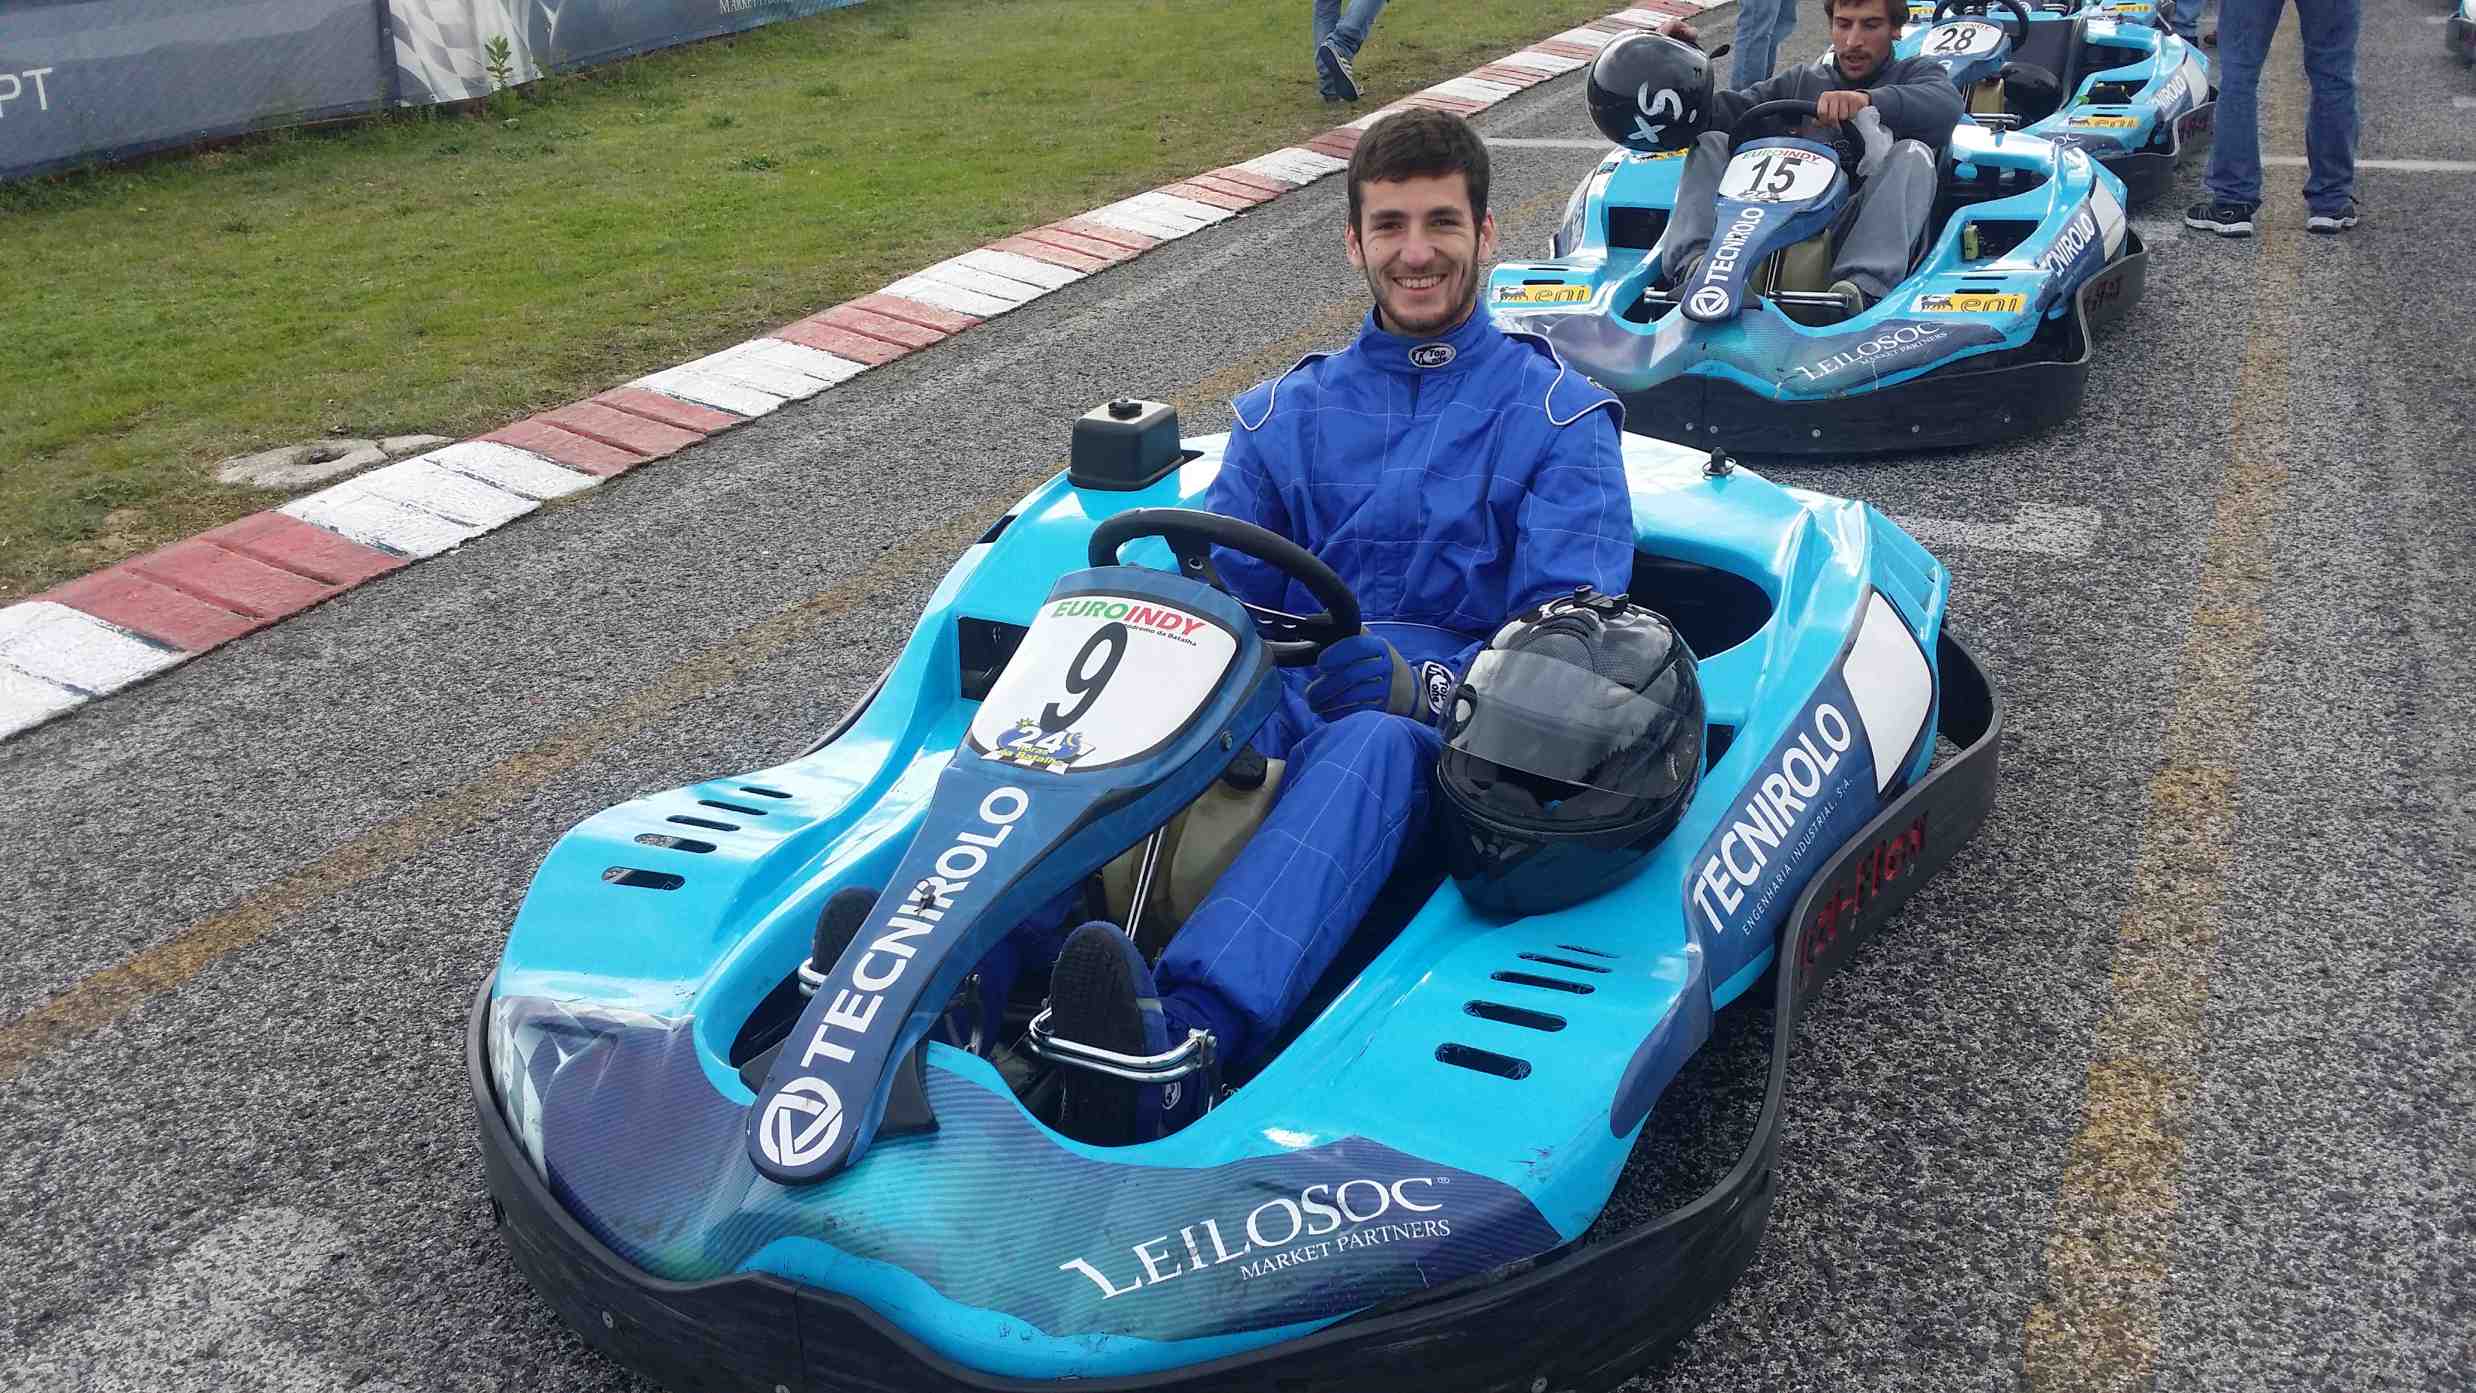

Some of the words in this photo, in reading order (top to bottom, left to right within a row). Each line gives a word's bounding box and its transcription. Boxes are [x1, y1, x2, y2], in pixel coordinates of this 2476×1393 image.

[1934, 27, 1977, 51] 28
[1750, 156, 1801, 194] 15
[1704, 207, 1765, 285] TECNIROLO
[1960, 294, 2018, 313] eni
[1795, 322, 1941, 382] LEILOSOC
[1052, 601, 1206, 636] EUROINDY
[1039, 621, 1128, 733] 9
[1008, 726, 1067, 754] 24
[1693, 703, 1851, 934] TECNIROLO
[800, 786, 1030, 1068] TECNIROLO
[1742, 863, 1793, 937] ENGENHARIA
[1058, 1176, 1443, 1300] LEILOSOC
[1240, 1241, 1331, 1281] MARKET
[1336, 1219, 1451, 1254] PARTNERS
